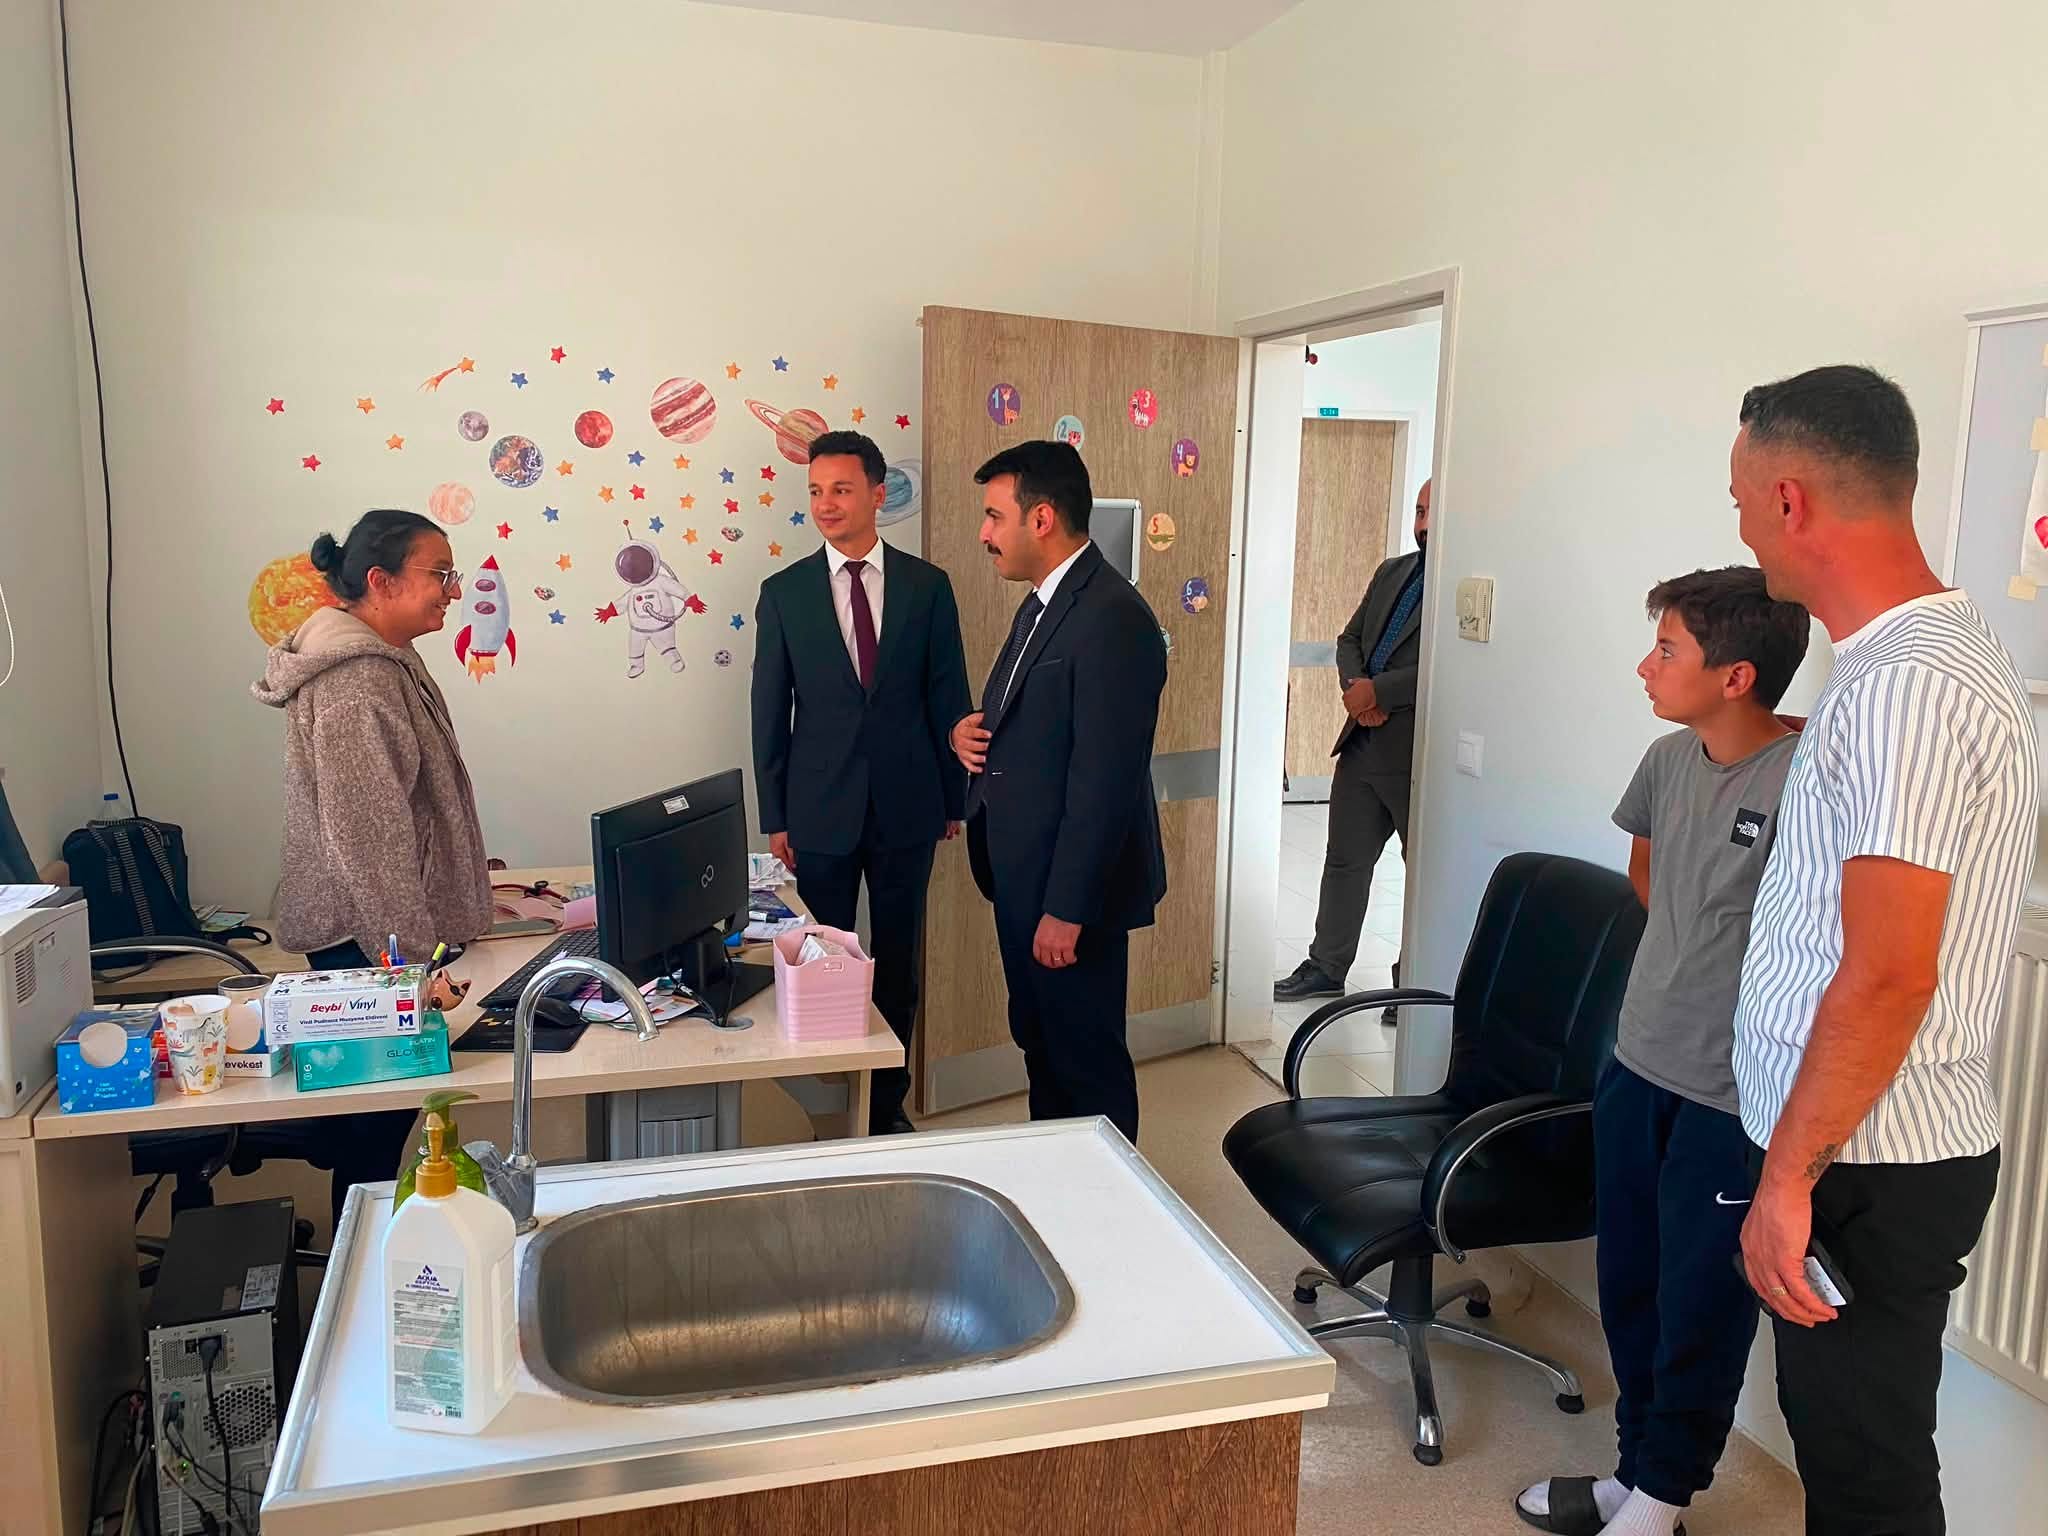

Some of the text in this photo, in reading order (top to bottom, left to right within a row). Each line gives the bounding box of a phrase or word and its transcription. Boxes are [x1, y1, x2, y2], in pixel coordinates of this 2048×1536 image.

[992, 387, 999, 409] 1
[1143, 390, 1151, 408] 3
[1057, 420, 1067, 440] 2
[1176, 443, 1184, 461] 4
[1186, 580, 1193, 596] 6
[310, 997, 377, 1014] Beybi Vinyl
[275, 1024, 288, 1032] CE
[398, 1014, 414, 1027] M
[224, 1060, 263, 1069] evokast
[417, 1274, 438, 1282] AQUA
